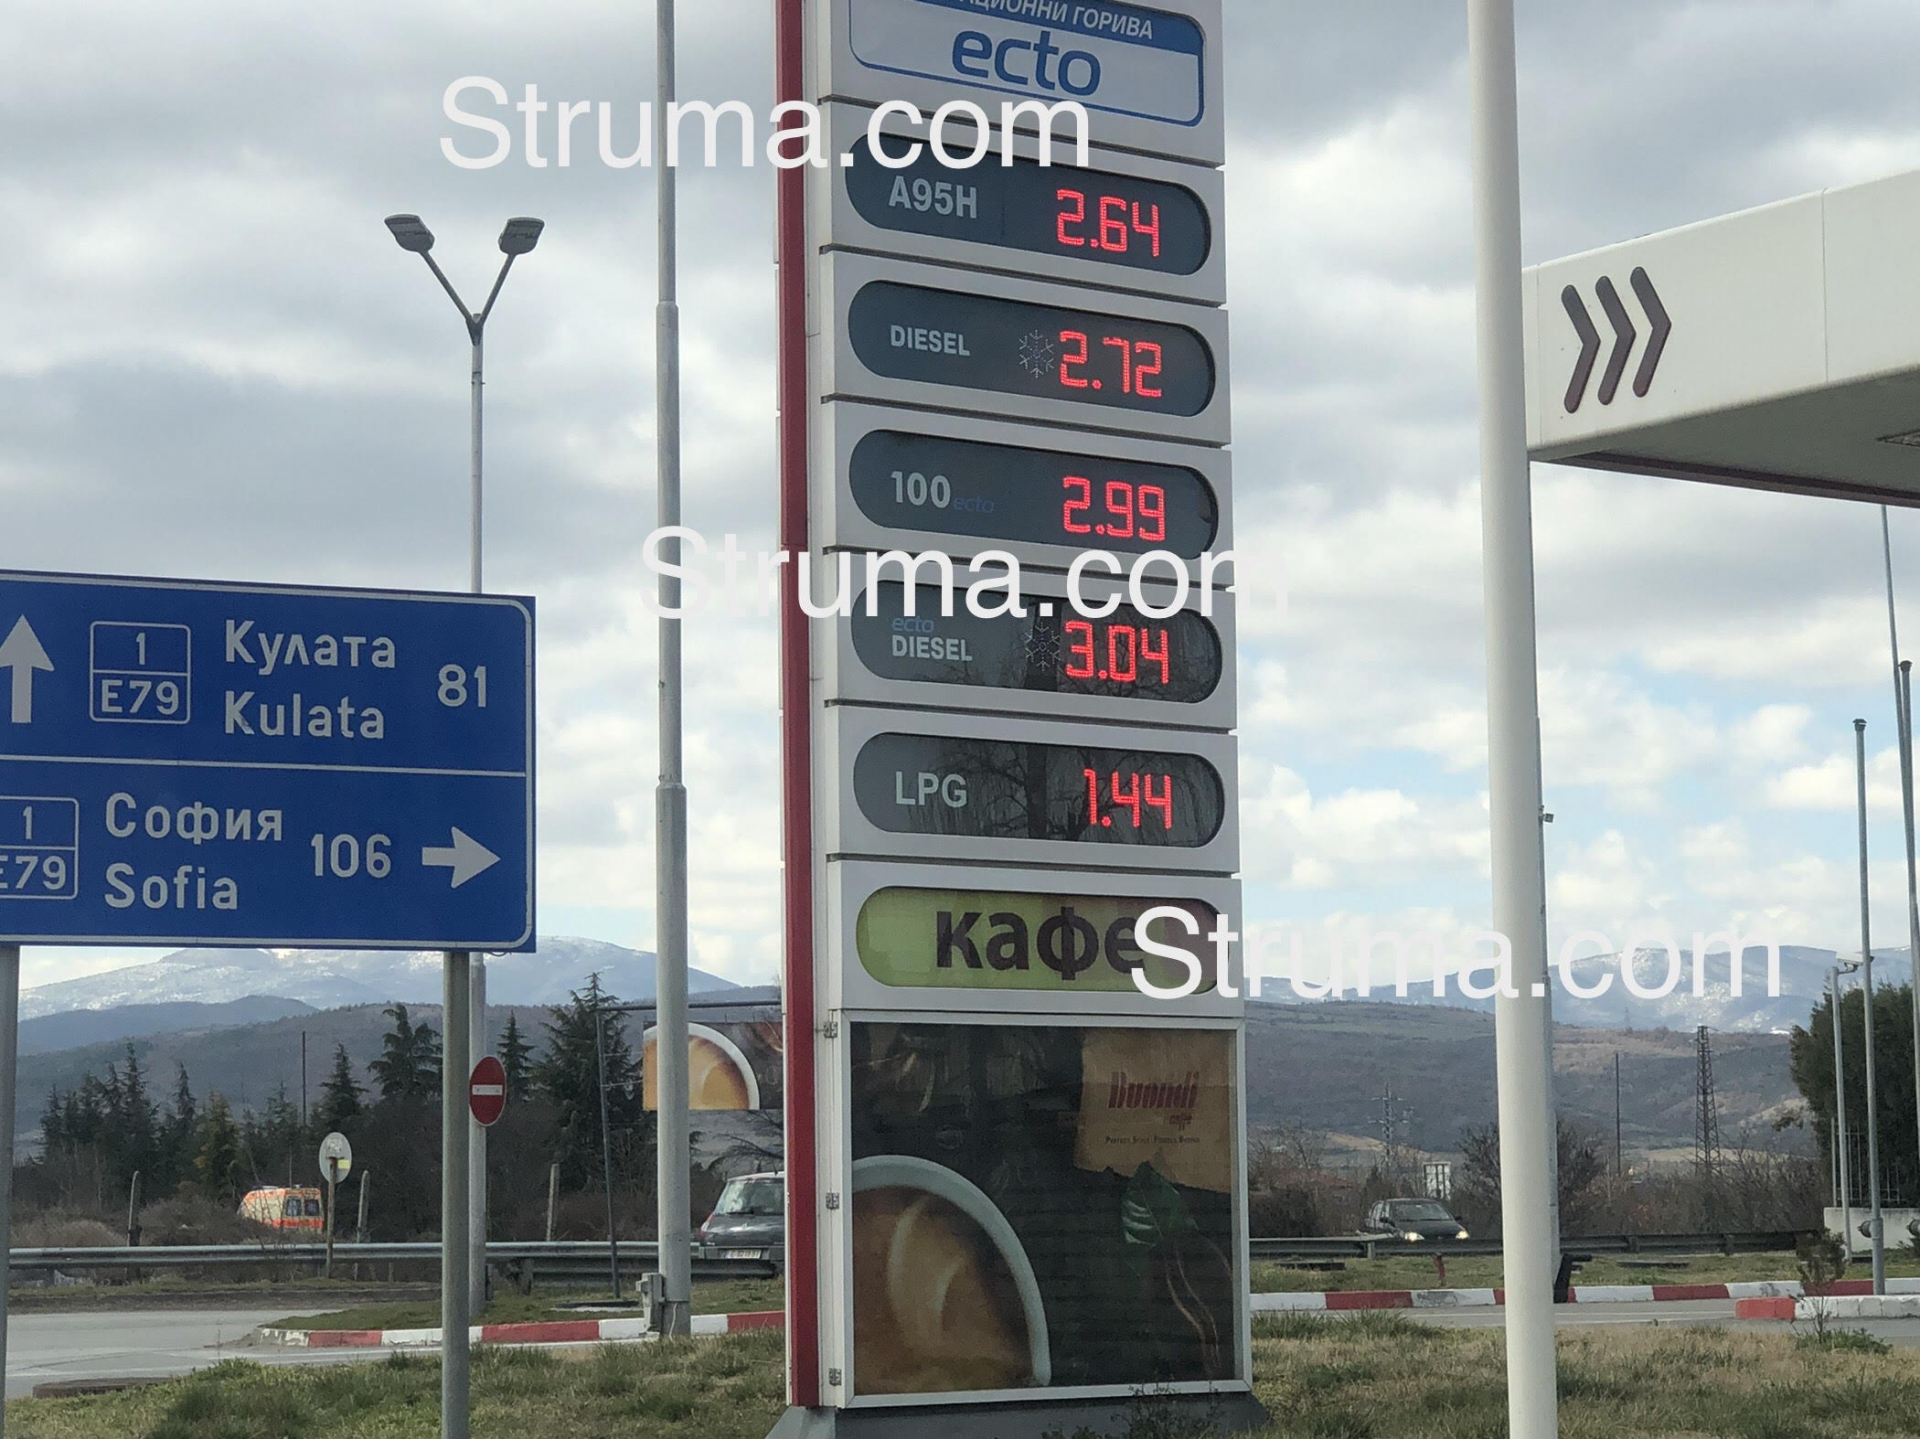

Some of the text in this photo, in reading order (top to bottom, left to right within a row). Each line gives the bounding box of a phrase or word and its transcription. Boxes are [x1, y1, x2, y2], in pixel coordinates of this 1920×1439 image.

[1072, 6, 1153, 39] ГОРИВА
[952, 30, 1101, 96] ecto
[1057, 189, 1159, 257] 2.64
[890, 325, 1162, 397] DIESEL 2.72
[890, 470, 1165, 541] 100 ecto 2.99
[136, 633, 146, 665] 1
[225, 620, 395, 675] Кулата
[891, 615, 934, 633] ecto
[892, 620, 1169, 684] DIESEL 3.04
[101, 680, 179, 715] E79
[438, 664, 487, 707] 81
[225, 691, 385, 739] Kulata
[23, 806, 33, 839] 1
[106, 792, 283, 844] София
[895, 768, 1172, 829] LPG 1.44
[310, 834, 392, 878] 106
[105, 863, 238, 909] Sofia
[936, 907, 1145, 981] кафе
